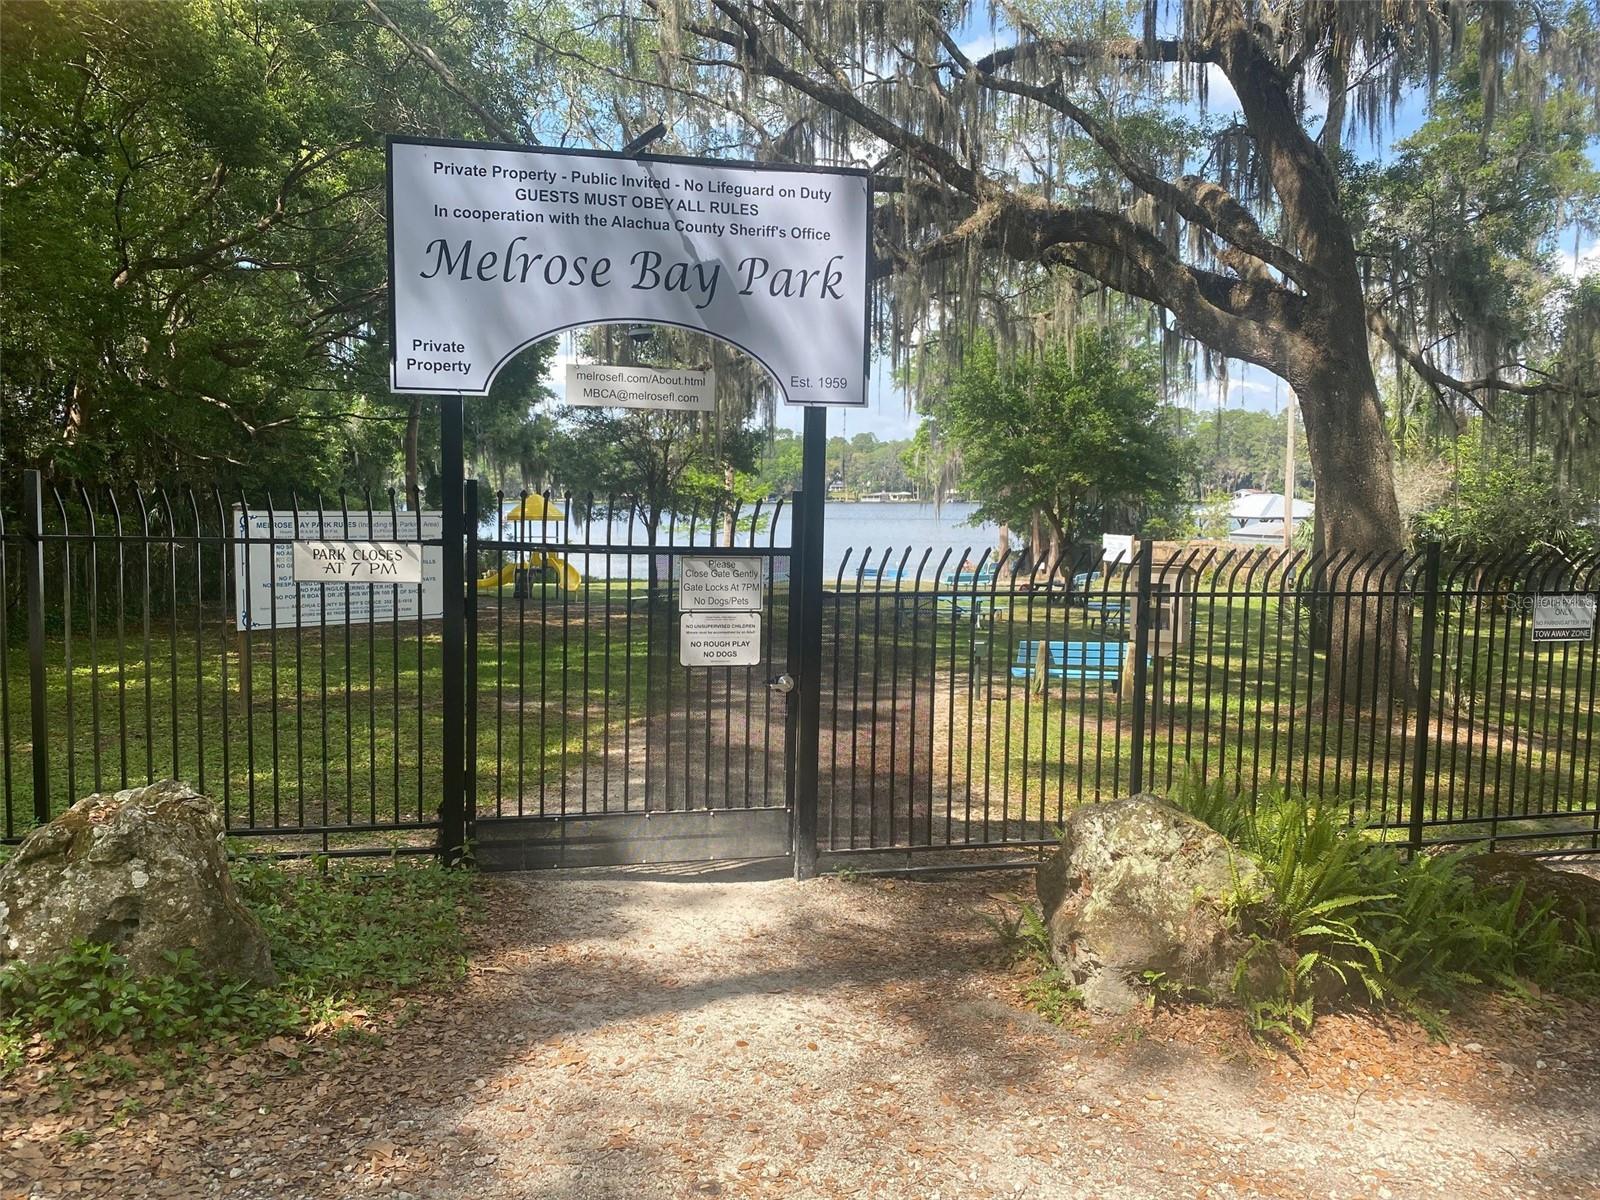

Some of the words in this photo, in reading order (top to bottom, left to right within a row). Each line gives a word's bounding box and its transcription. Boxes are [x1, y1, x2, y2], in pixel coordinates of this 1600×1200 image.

[434, 162, 487, 177] Private
[492, 165, 556, 184] Property
[571, 171, 617, 186] Public
[622, 174, 670, 189] Invited
[685, 179, 703, 192] No
[709, 182, 774, 199] Lifeguard
[778, 188, 796, 198] on
[800, 187, 832, 203] Duty
[515, 188, 579, 204] GUESTS
[584, 193, 627, 207] MUST
[632, 196, 673, 210] OBEY
[676, 199, 705, 213] ALL
[710, 202, 759, 216] RULES
[434, 205, 448, 217] In
[453, 207, 544, 222] cooperation
[549, 211, 580, 225] with
[585, 213, 607, 226] the
[611, 216, 670, 231] Alachua
[674, 219, 725, 237] County
[729, 223, 787, 239] Sheriff's
[791, 227, 831, 241] Office
[419, 236, 612, 288] Melrose
[630, 250, 721, 310] Bay
[737, 255, 844, 300] Park
[412, 339, 465, 353] Private
[407, 358, 471, 375] Property
[576, 371, 706, 388] melrosefl.com/About.html
[790, 375, 813, 388] Est.
[818, 377, 848, 389] 1959
[583, 388, 699, 403] MBCA@melrosefl.com
[313, 547, 346, 560] PARK
[353, 549, 403, 561] CLOSES
[323, 562, 344, 574] AT
[351, 562, 361, 576] 7
[370, 563, 398, 574] PM
[708, 560, 736, 569] Please
[685, 569, 709, 578] Close
[711, 569, 731, 578] Gate
[733, 569, 759, 580] Gently
[683, 583, 704, 592] Gate
[705, 583, 729, 592] Locks
[730, 583, 740, 592] At
[742, 583, 760, 592] 7PM
[694, 597, 706, 605] No
[708, 596, 749, 607] Dogs/Pets
[1555, 608, 1573, 616] ONLY
[1535, 630, 1551, 638] TOW
[1571, 629, 1590, 637] ZONE
[732, 640, 751, 648] PLAY
